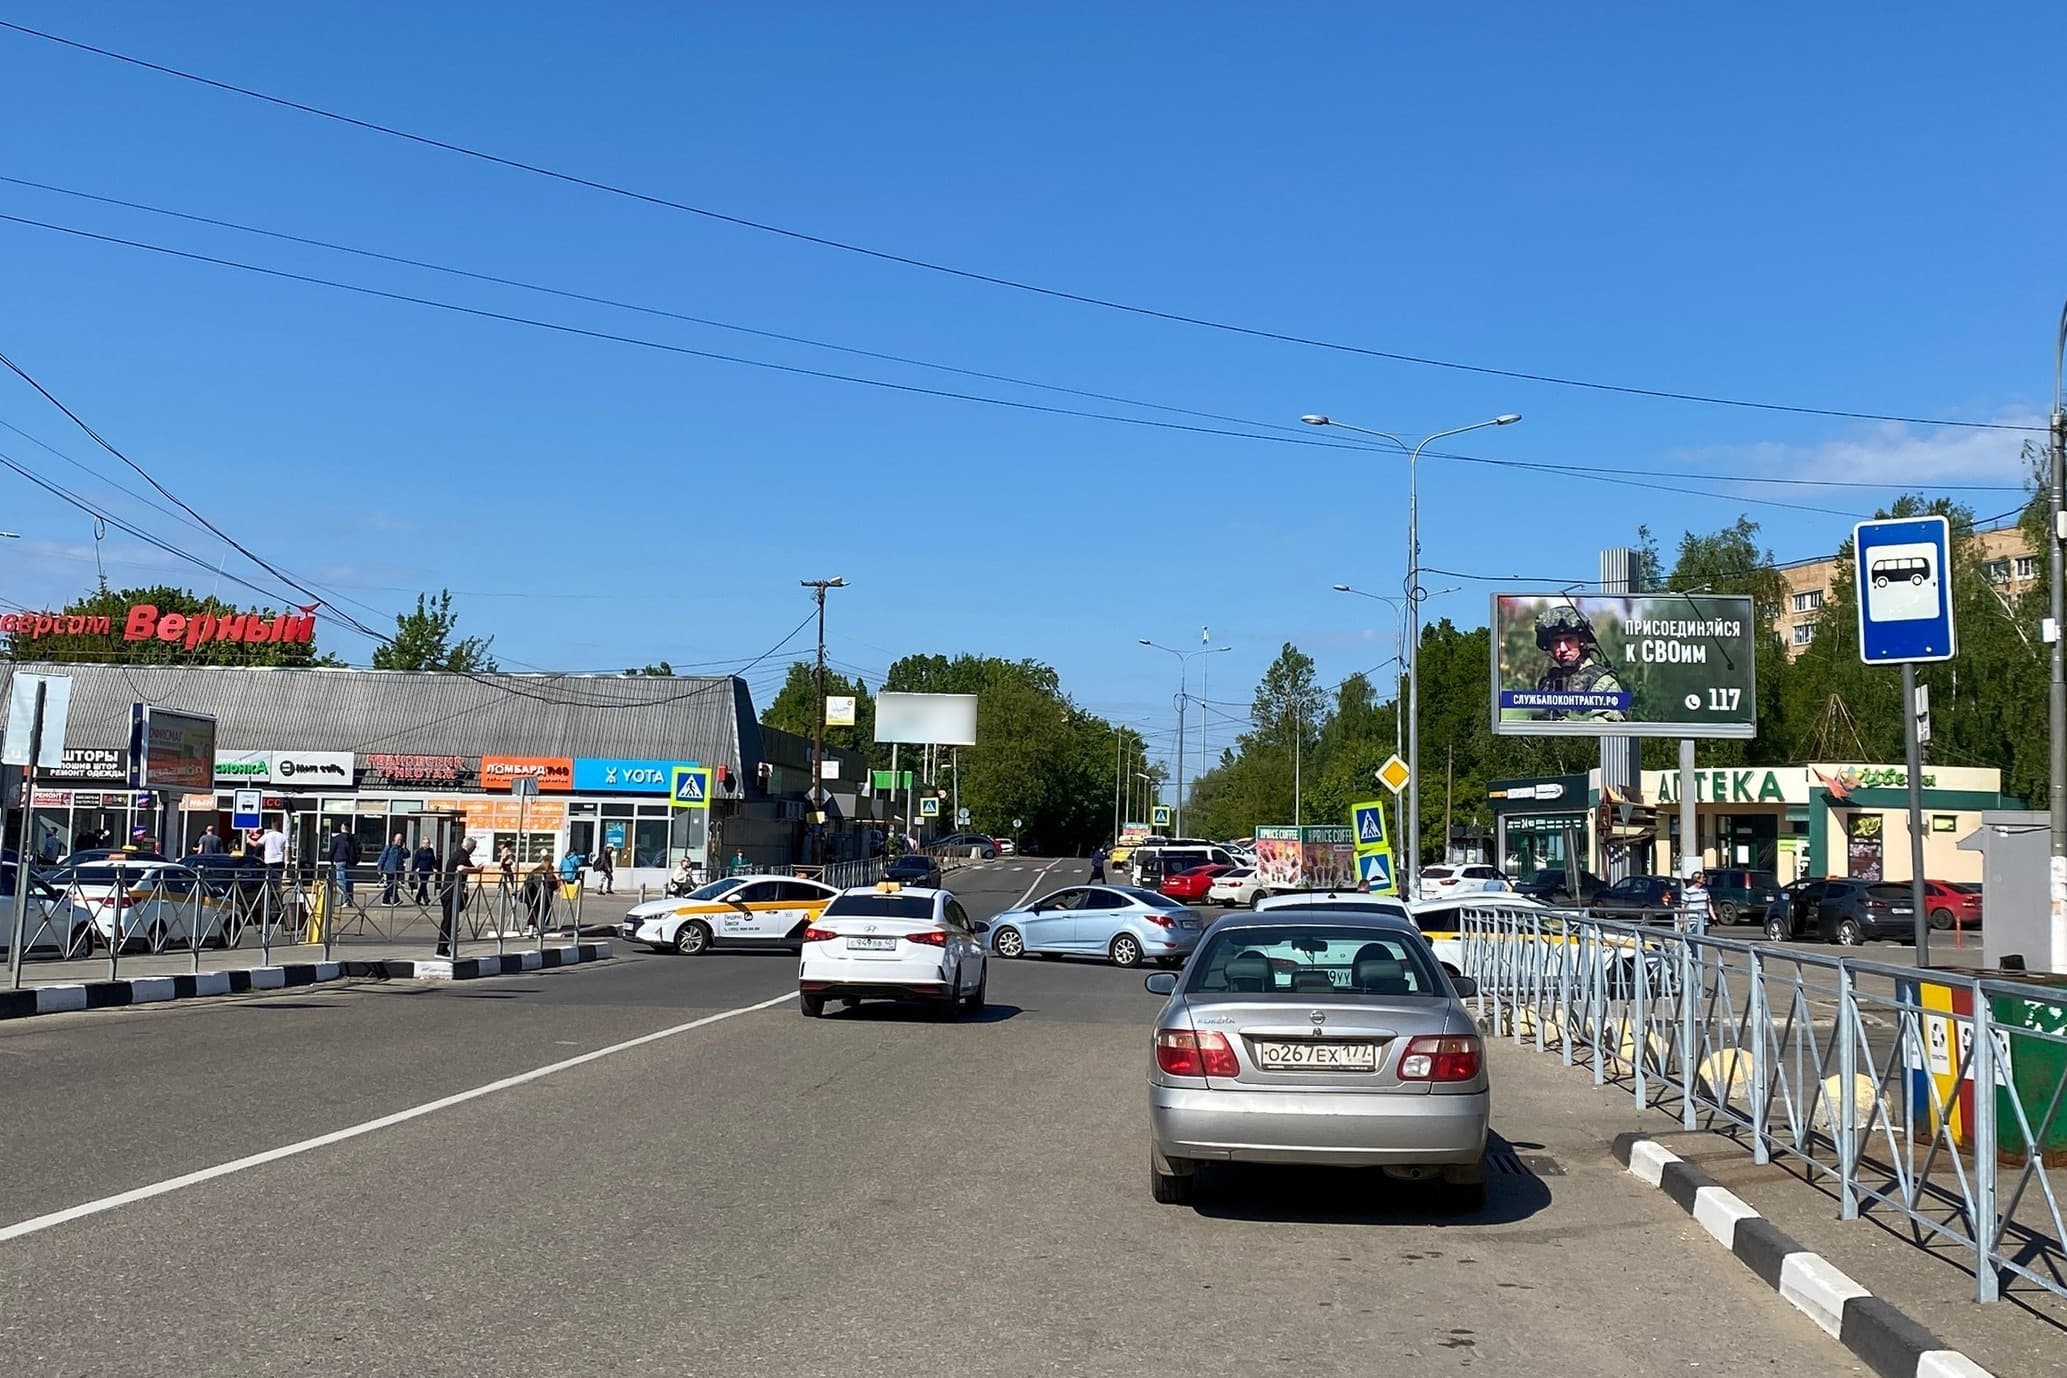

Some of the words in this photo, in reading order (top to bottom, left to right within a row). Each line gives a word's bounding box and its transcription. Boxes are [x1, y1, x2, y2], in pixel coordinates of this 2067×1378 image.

[123, 602, 321, 650] Верный
[1625, 617, 1741, 638] ПРИСОЕДИНЯЙСЯ
[1641, 639, 1707, 663] СВОим
[1513, 694, 1619, 706] СЛУЖБАПОКОНТРАКТУ.РФ
[1708, 688, 1741, 710] 117
[62, 750, 119, 762] ШТОРЫ
[487, 763, 546, 776] ЛОМБАРД
[622, 769, 665, 784] YOTA
[1268, 1045, 1338, 1062] О267ЕХ
